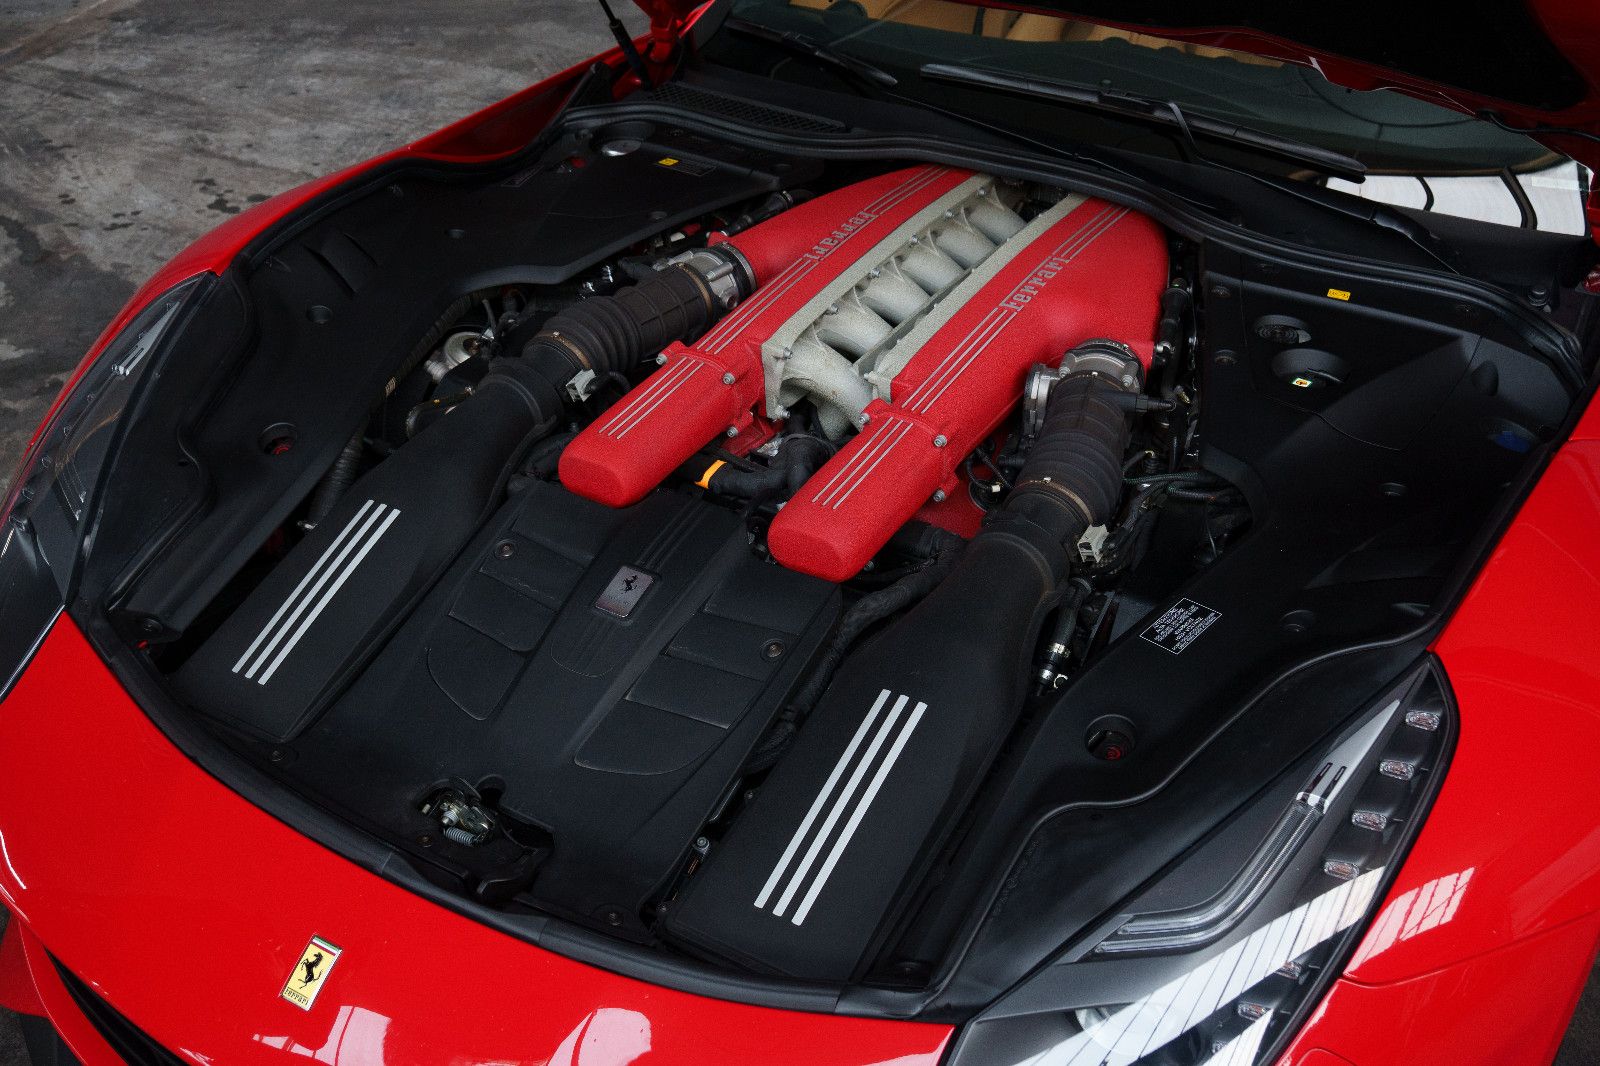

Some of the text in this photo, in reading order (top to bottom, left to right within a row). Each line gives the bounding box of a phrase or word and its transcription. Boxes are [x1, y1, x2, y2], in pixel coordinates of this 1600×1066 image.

[803, 211, 879, 261] Ferrari
[999, 256, 1071, 312] Ferrari
[283, 986, 309, 1006] Ferrari
